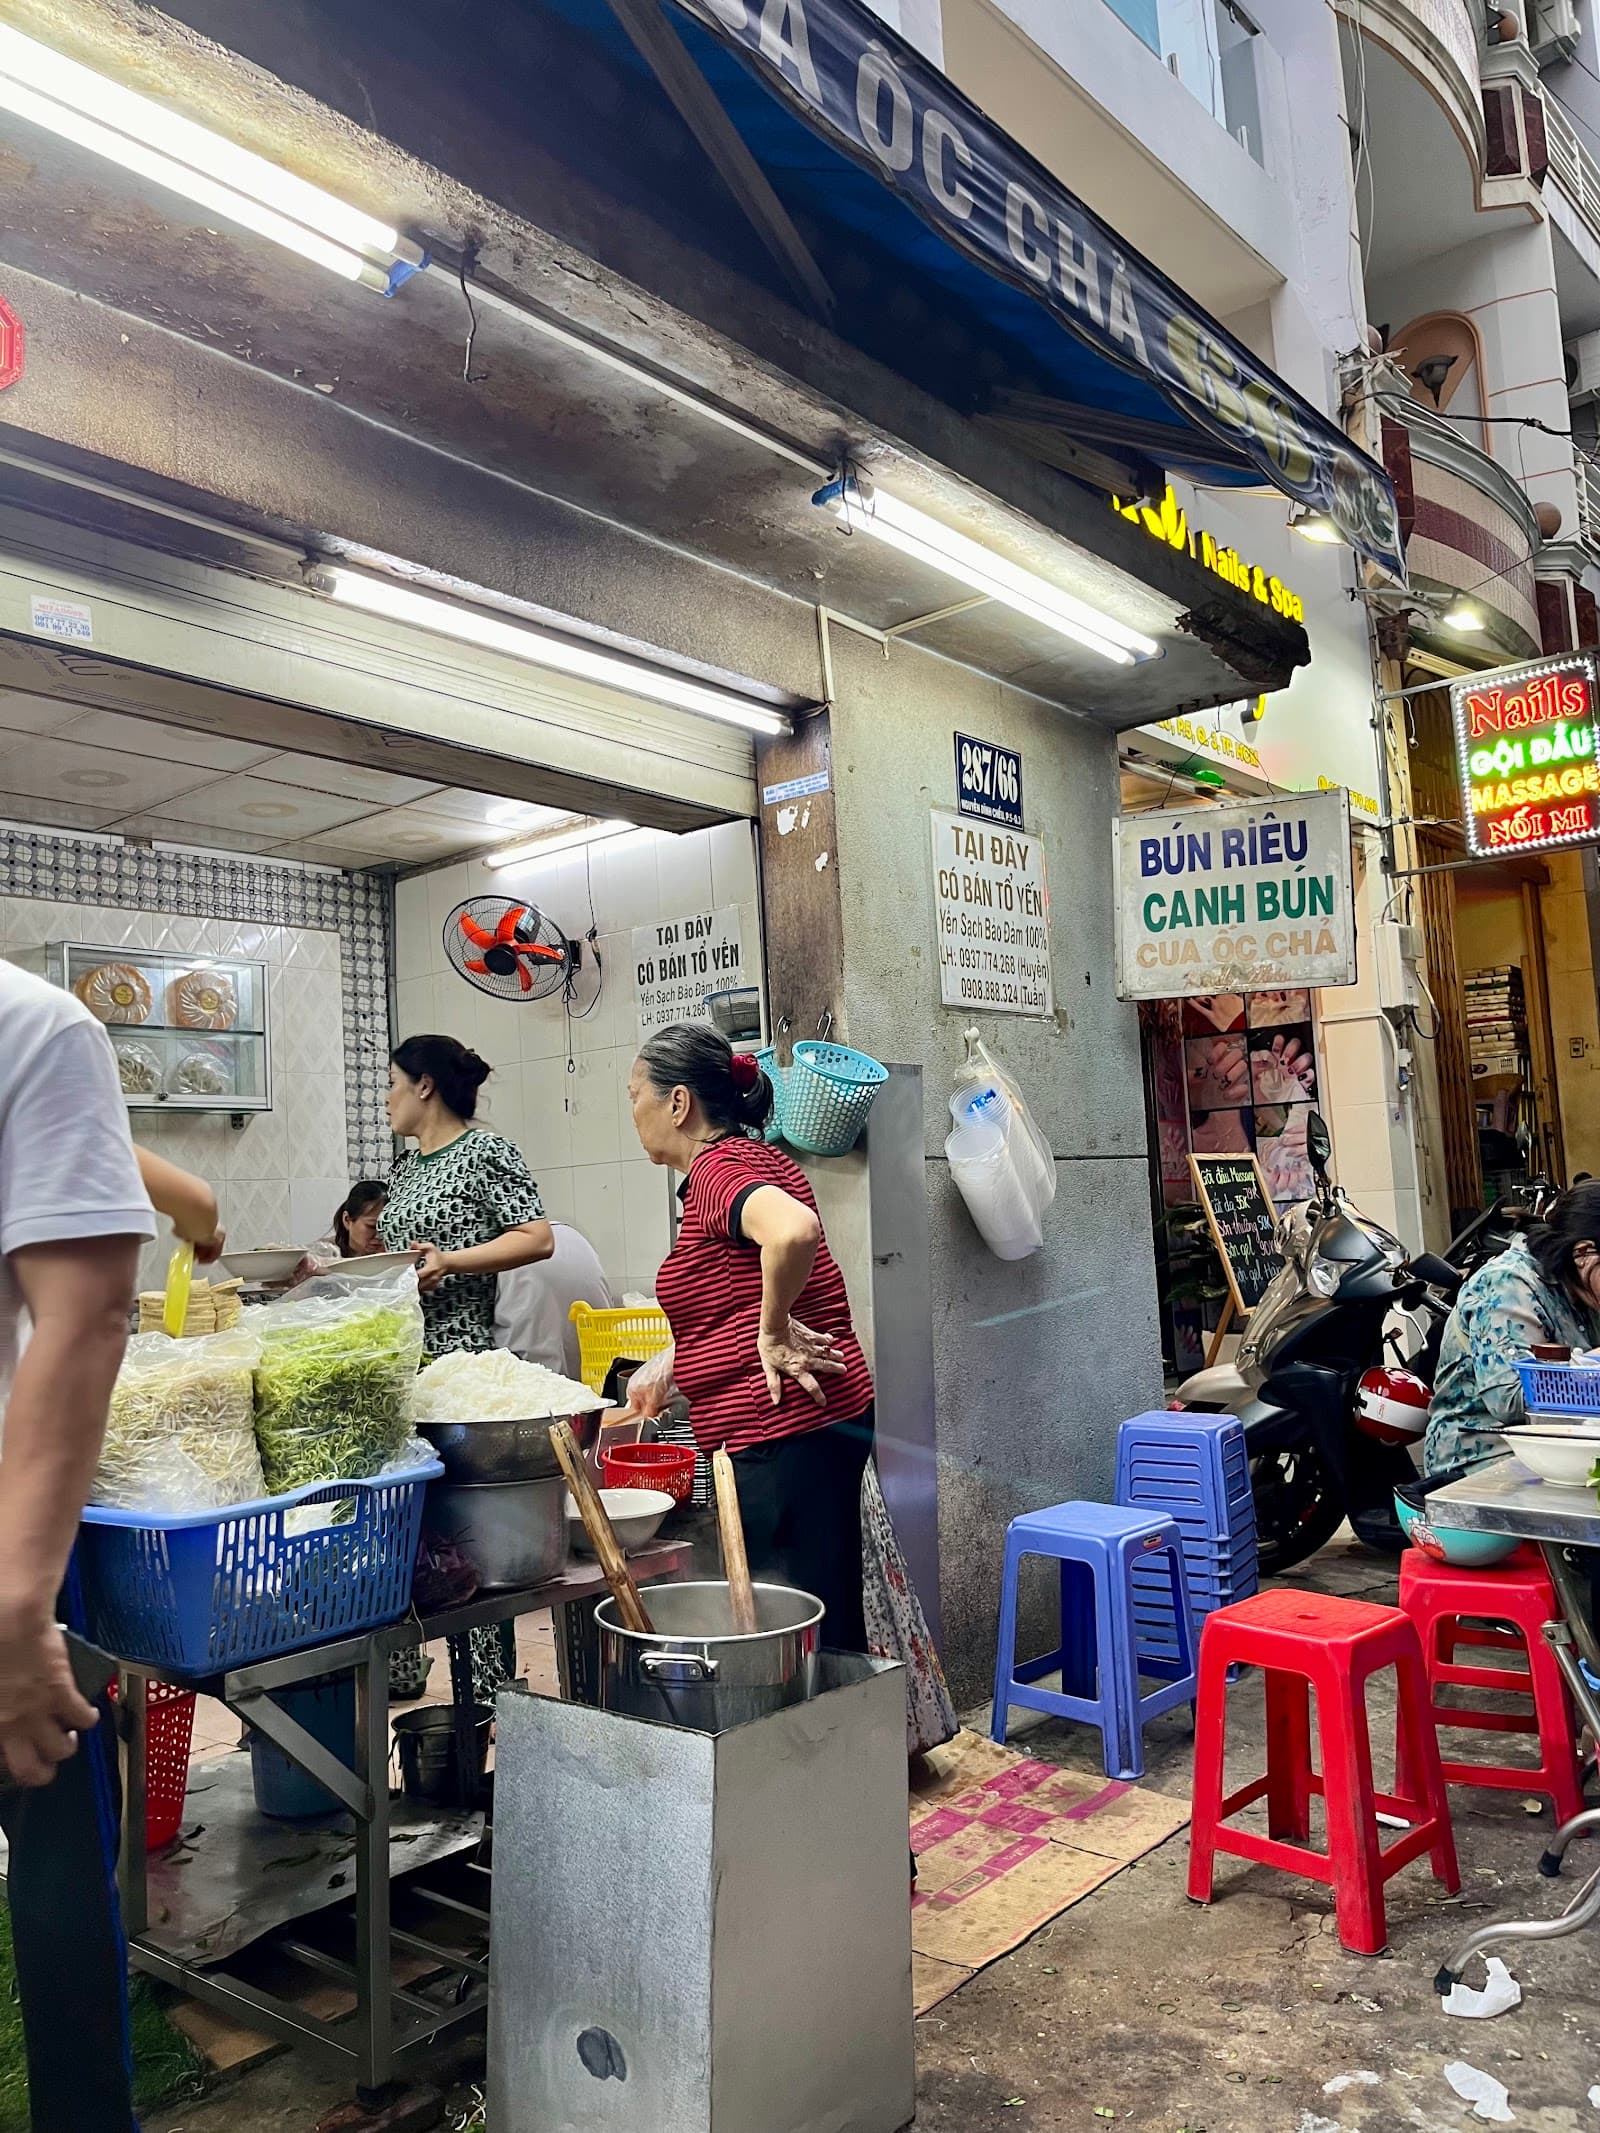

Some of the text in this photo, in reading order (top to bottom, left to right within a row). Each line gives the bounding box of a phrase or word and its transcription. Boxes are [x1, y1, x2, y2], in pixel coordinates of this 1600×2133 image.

[1004, 181, 1151, 364] CHẢ
[1202, 530, 1303, 624] Nails & Spa
[1467, 676, 1584, 738] Nails
[961, 742, 1018, 804] 287/66
[1470, 738, 1525, 778] GỘI
[1471, 765, 1600, 813] MASSAGE
[951, 826, 1029, 871] TẠI ĐÂY
[1488, 805, 1588, 844] NỐI MI
[1140, 822, 1212, 877] BÚN
[939, 867, 1043, 917] CÓ BÁN TỔ YẾN
[1143, 865, 1334, 933] CANH BÚN
[656, 915, 713, 948] TẠI ĐÂY
[939, 905, 1048, 951] Yến Sạch Bảo Đảm 100%
[1136, 917, 1337, 969] CUA ỐC CHẢ
[637, 936, 739, 986] CÓ BÁN TỔ YẾN
[939, 944, 957, 967] LH:
[959, 948, 1016, 975] 0937.774.268
[641, 1012, 655, 1026] LH:
[656, 1003, 706, 1024] 0937.774.268
[656, 988, 676, 1007] Sạch
[678, 984, 693, 1000] Bảo
[961, 978, 1018, 1004] 0908.888.324
